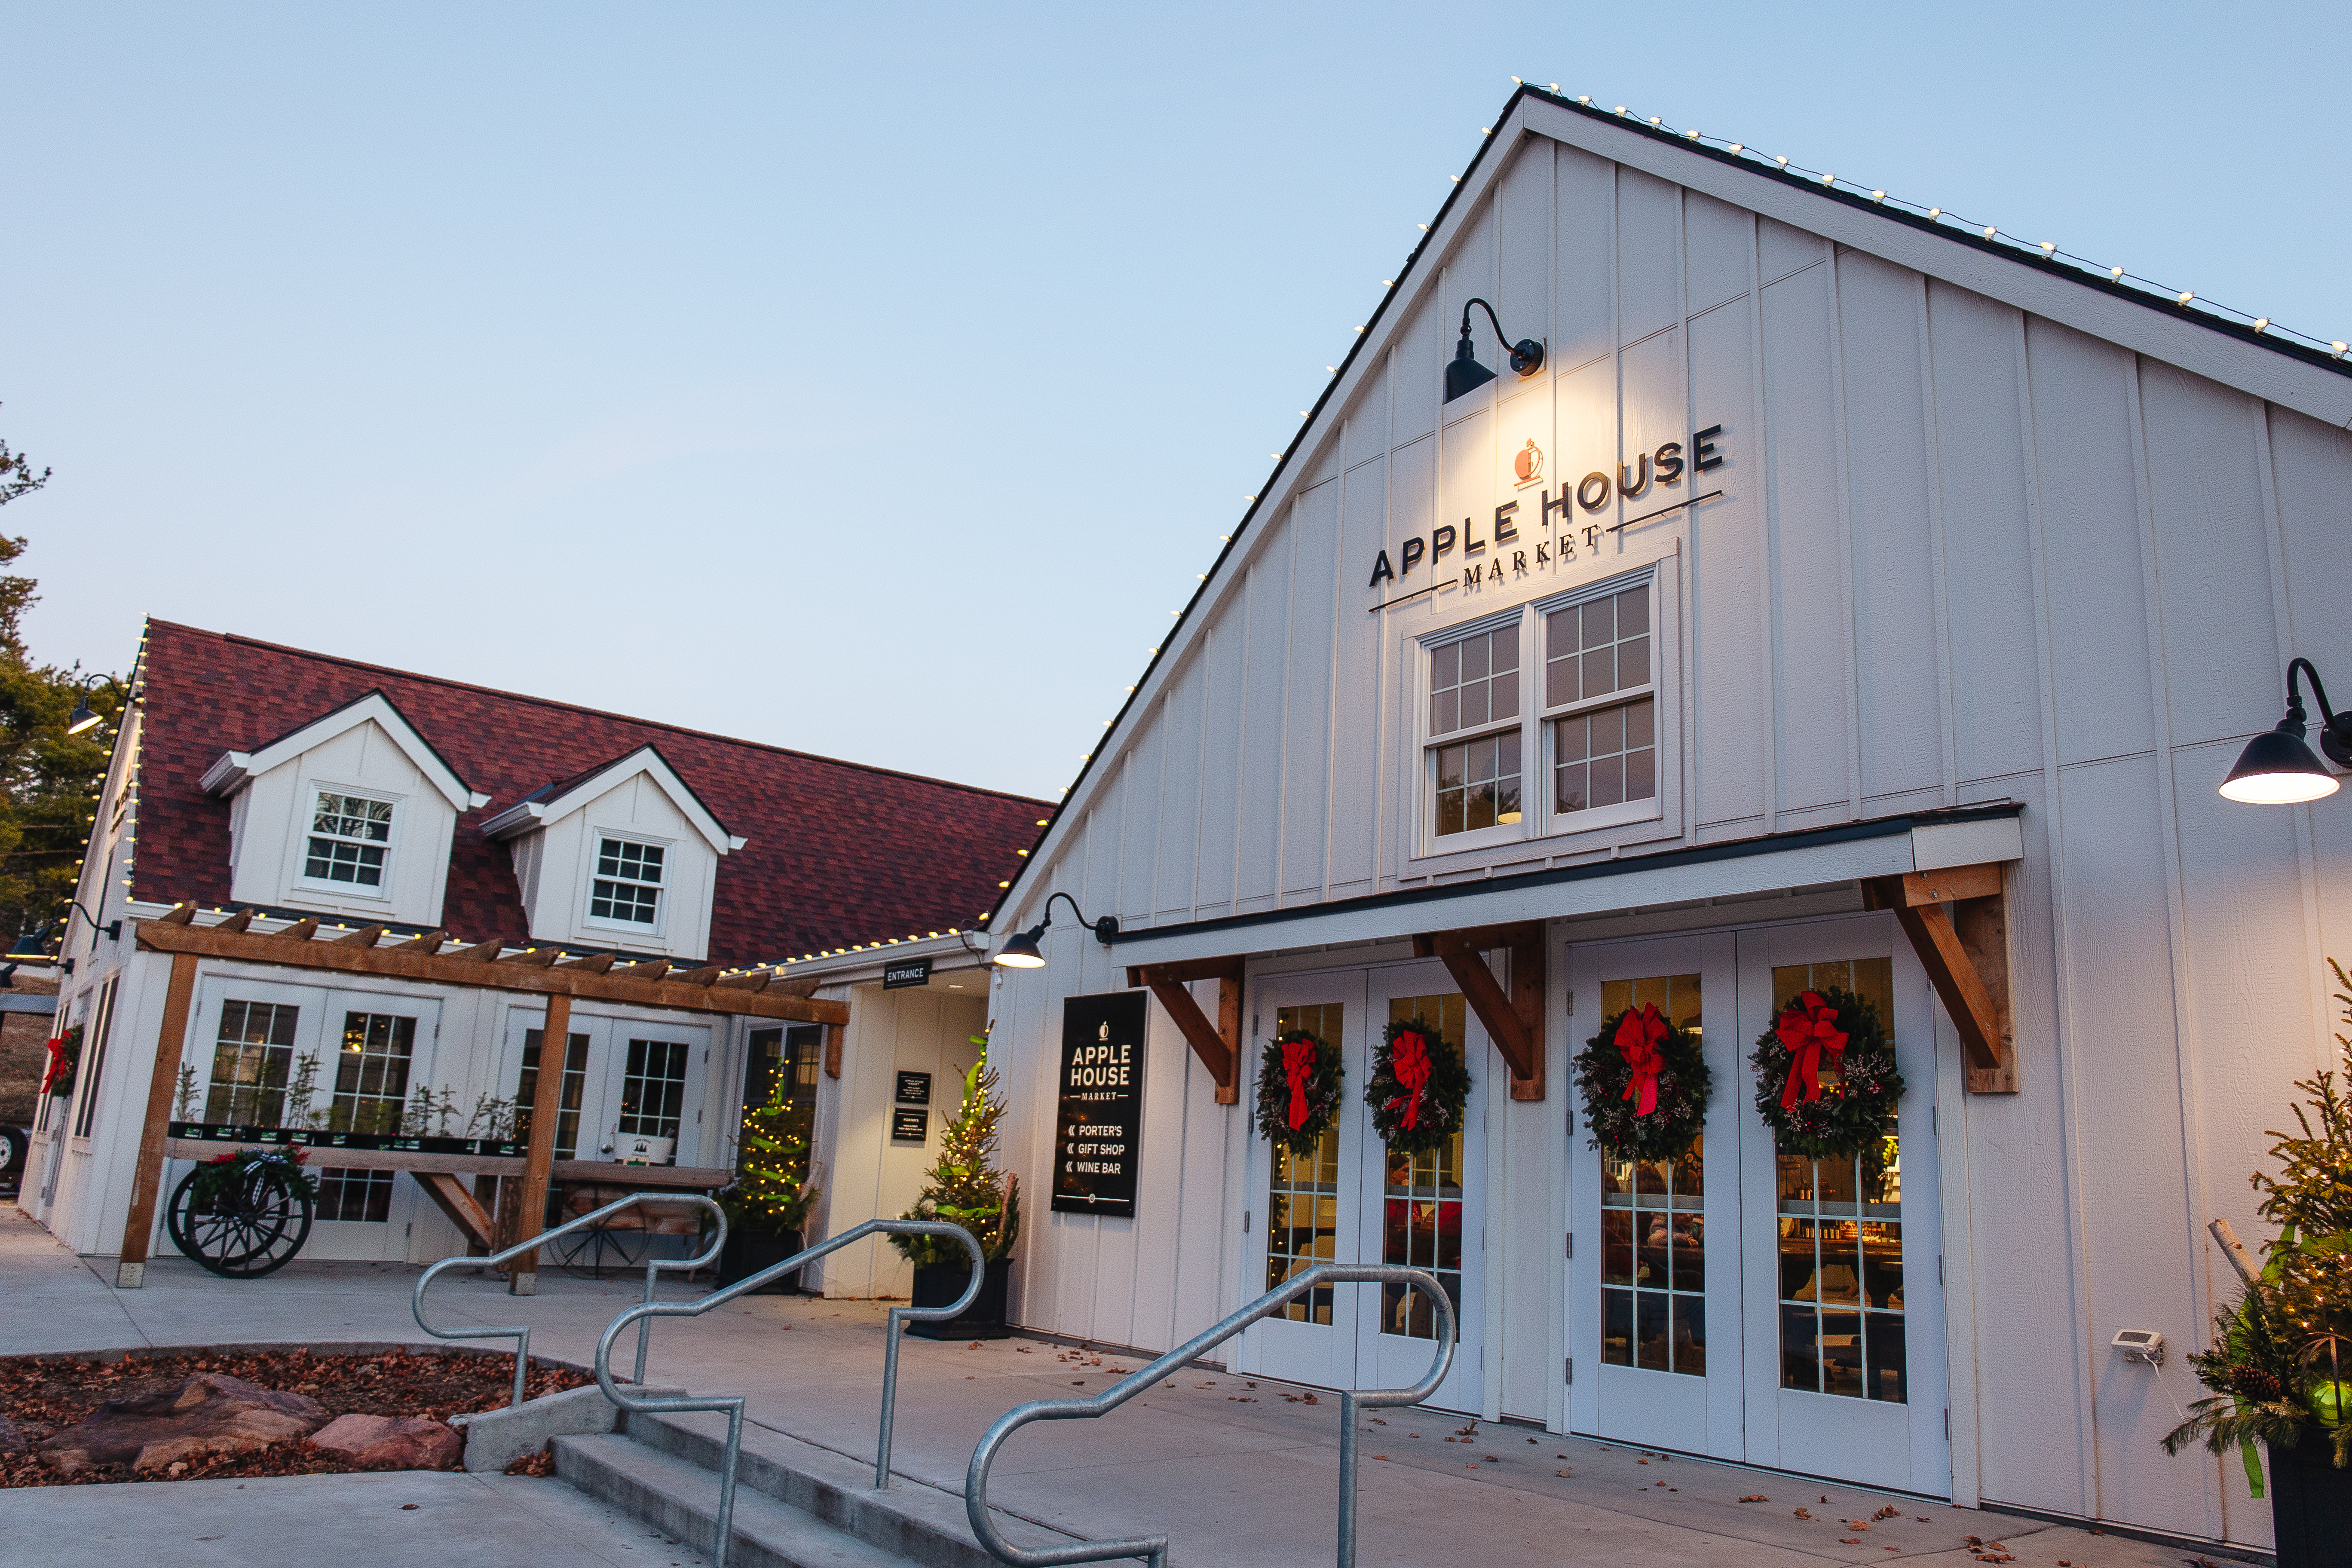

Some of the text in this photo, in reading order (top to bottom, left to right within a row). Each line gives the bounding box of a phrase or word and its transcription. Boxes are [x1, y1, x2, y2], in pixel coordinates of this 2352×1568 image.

[1369, 424, 1723, 588] APPLE HOUSE
[1463, 524, 1602, 588] MARKET
[888, 968, 924, 981] ENTRANCE
[1072, 1044, 1131, 1066] APPLE
[1070, 1066, 1130, 1086] HOUSE
[1081, 1092, 1117, 1101] MARKET
[1079, 1125, 1123, 1137] PORTER'S
[1078, 1143, 1125, 1155] GIFT SHOP
[1077, 1161, 1121, 1174] WINE BAR
